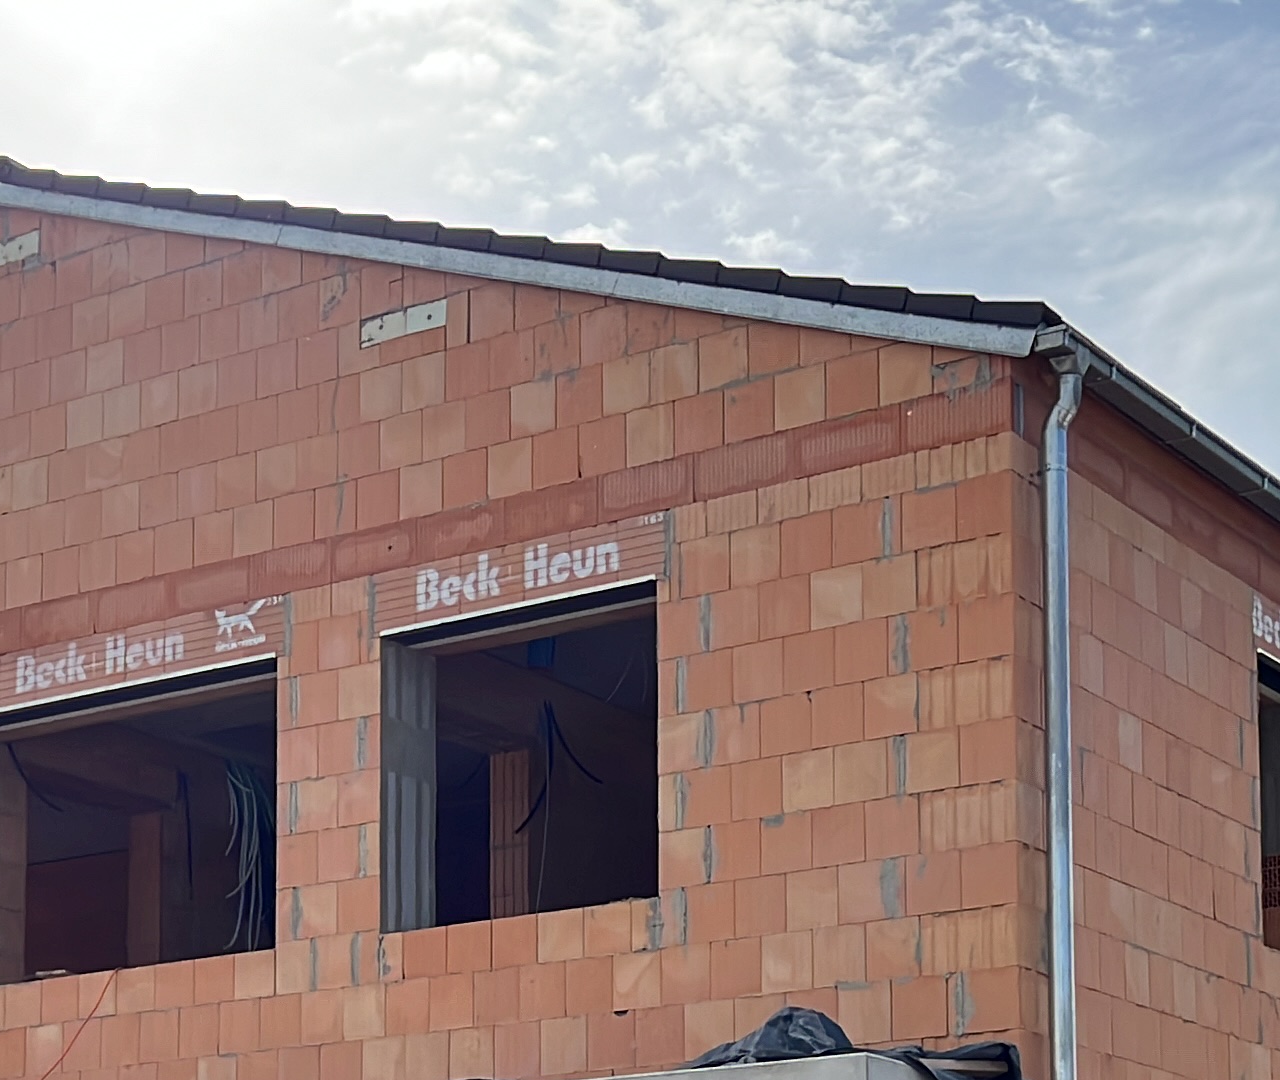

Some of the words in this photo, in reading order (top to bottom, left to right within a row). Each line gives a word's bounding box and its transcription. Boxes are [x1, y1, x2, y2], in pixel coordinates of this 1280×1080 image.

[415, 553, 500, 612] Beck
[523, 541, 619, 590] Heun
[15, 641, 87, 695] Beck
[105, 631, 185, 675] Heun
